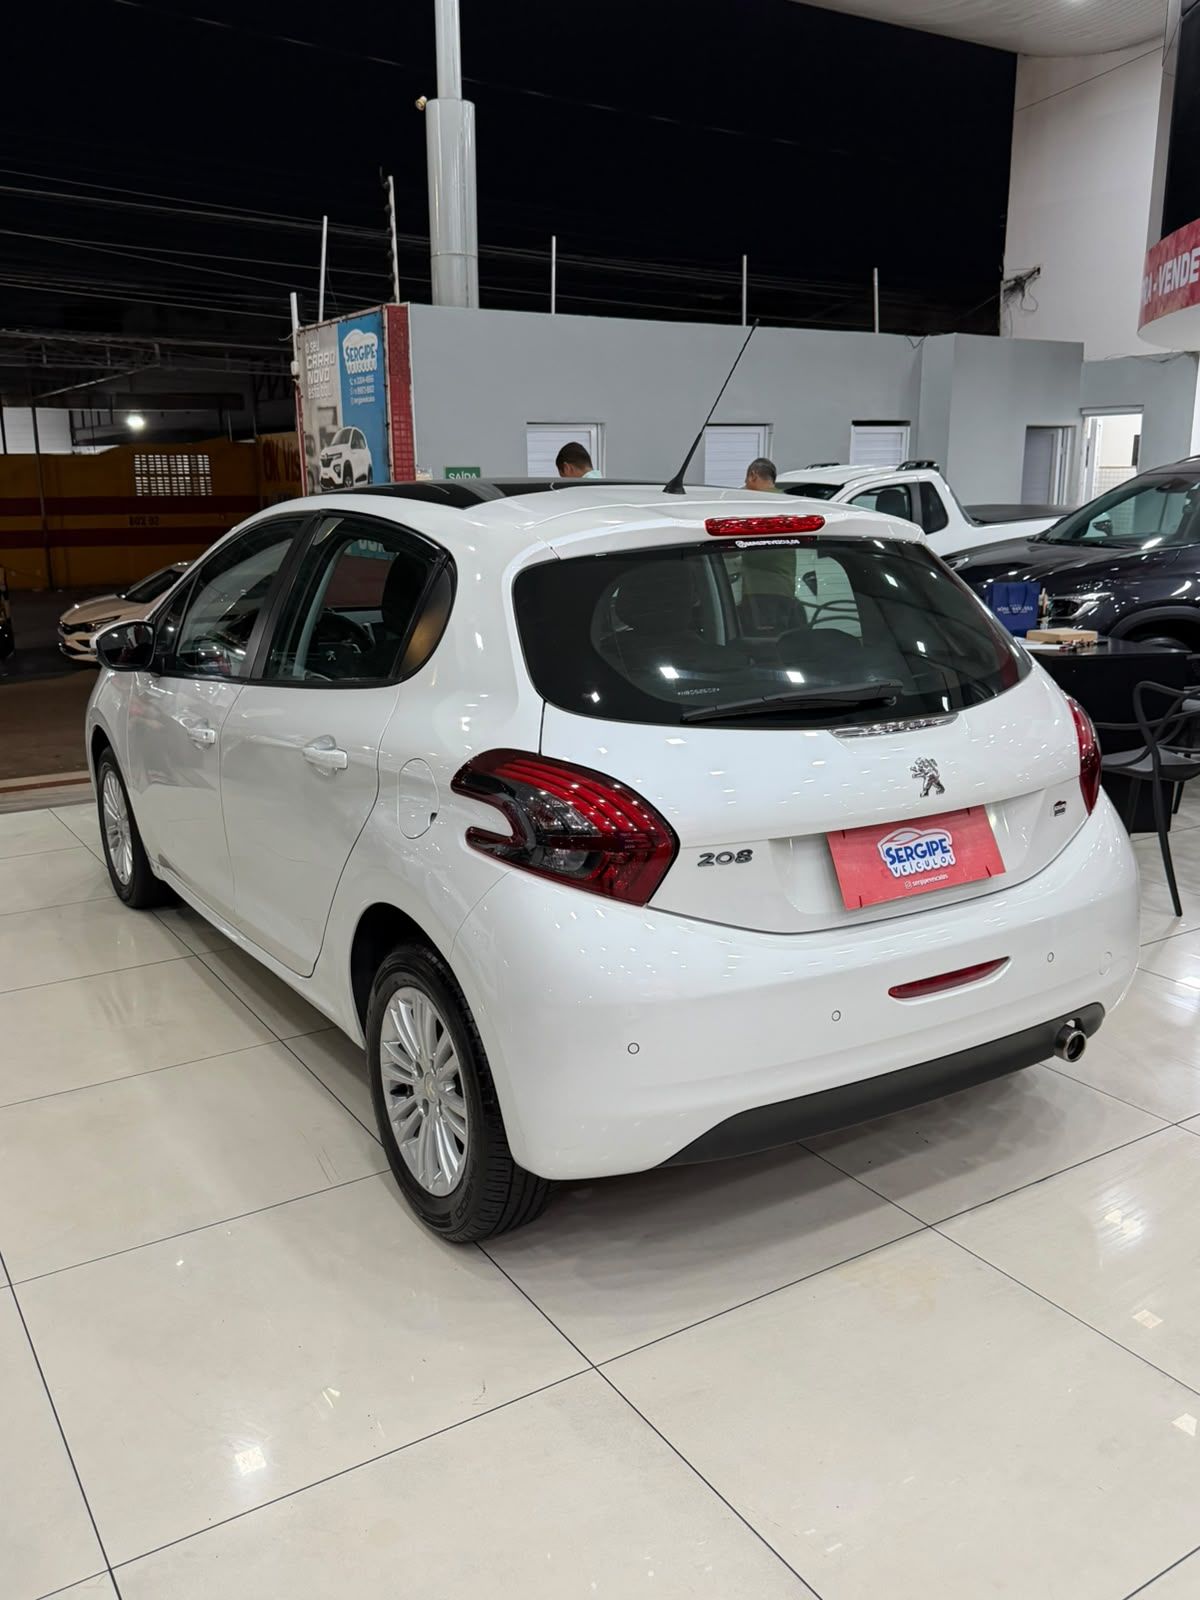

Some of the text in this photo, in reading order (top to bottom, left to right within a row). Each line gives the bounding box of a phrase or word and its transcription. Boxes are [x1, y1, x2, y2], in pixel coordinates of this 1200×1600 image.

[1158, 246, 1200, 297] VENDE
[306, 351, 336, 369] CARRO
[345, 343, 376, 362] SERGIPE
[307, 368, 330, 385] NOVO
[697, 848, 754, 868] 208
[885, 838, 951, 866] SERGIPE
